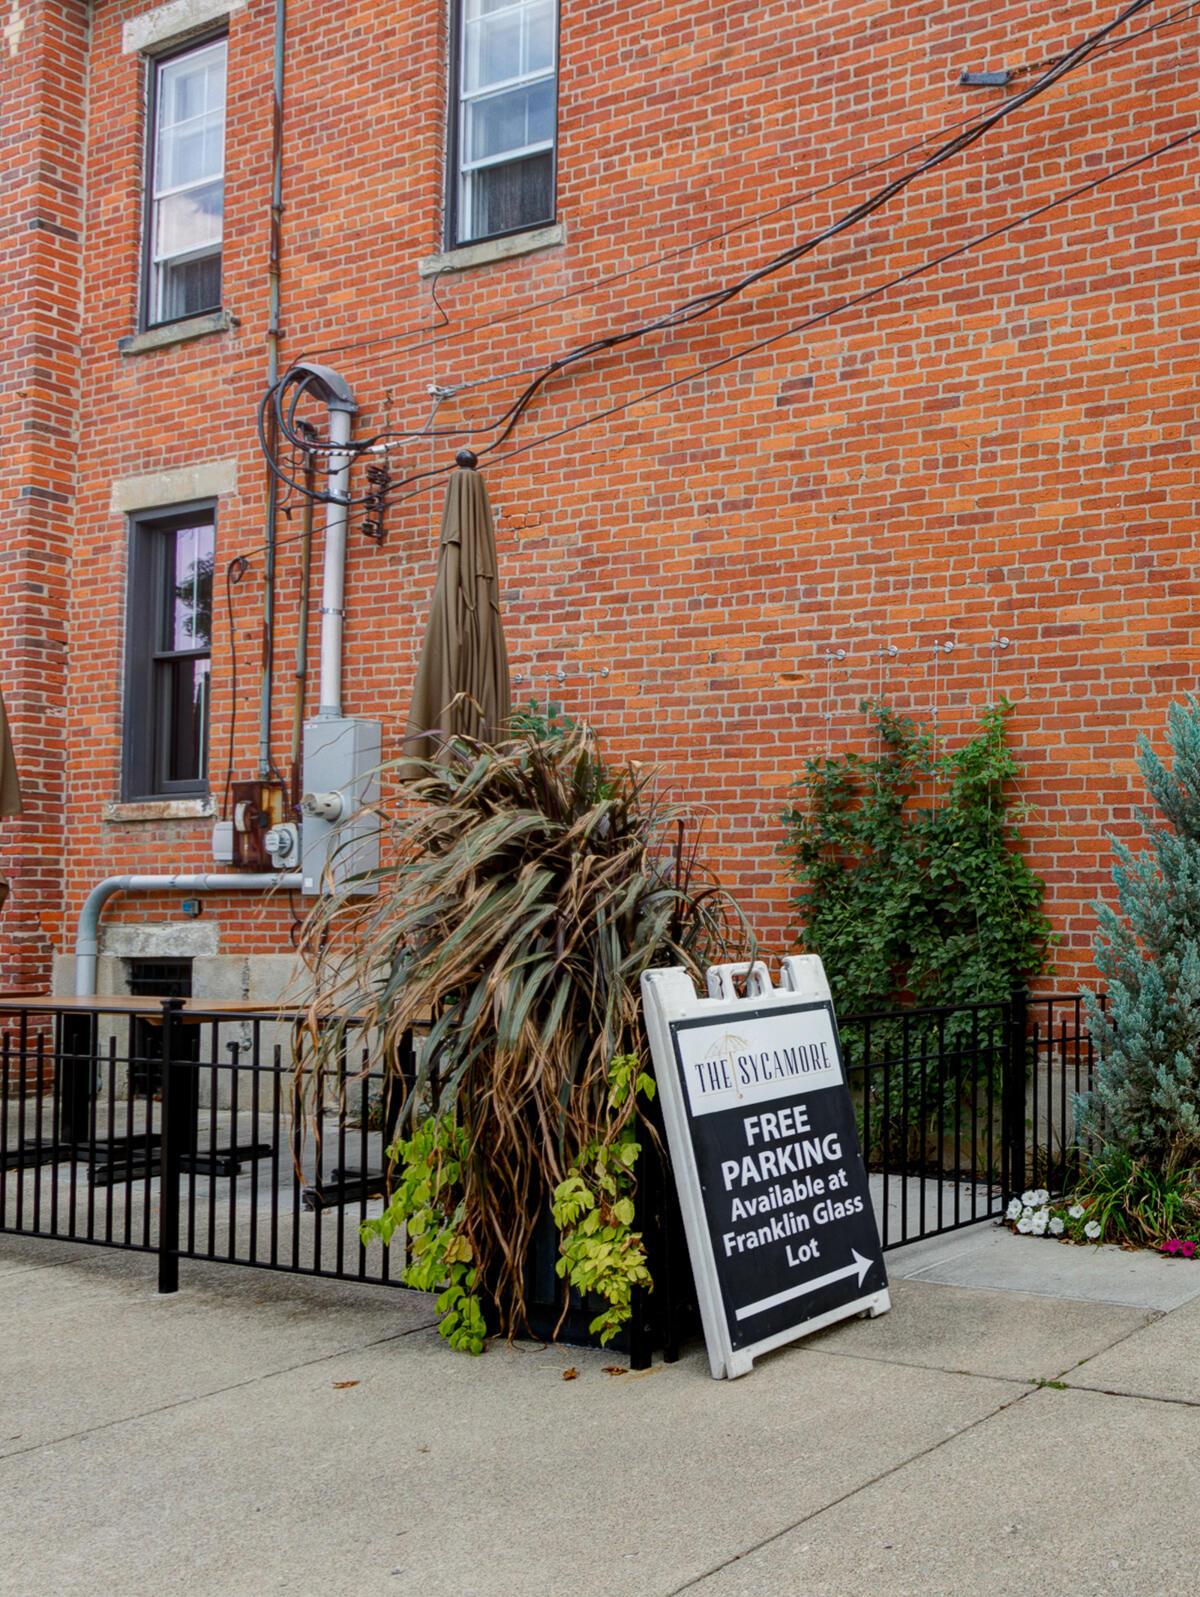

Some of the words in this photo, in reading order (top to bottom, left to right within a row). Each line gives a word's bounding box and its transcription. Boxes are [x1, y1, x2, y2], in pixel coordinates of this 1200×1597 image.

[694, 1057, 733, 1094] THE
[737, 1041, 832, 1086] SYCAMORE
[743, 1104, 811, 1147] FREE
[720, 1132, 842, 1192] PARKING
[731, 1179, 824, 1223] Available
[828, 1167, 849, 1193] at
[722, 1213, 811, 1258] Franklin
[813, 1194, 864, 1226] Glass
[785, 1238, 820, 1268] Lot
